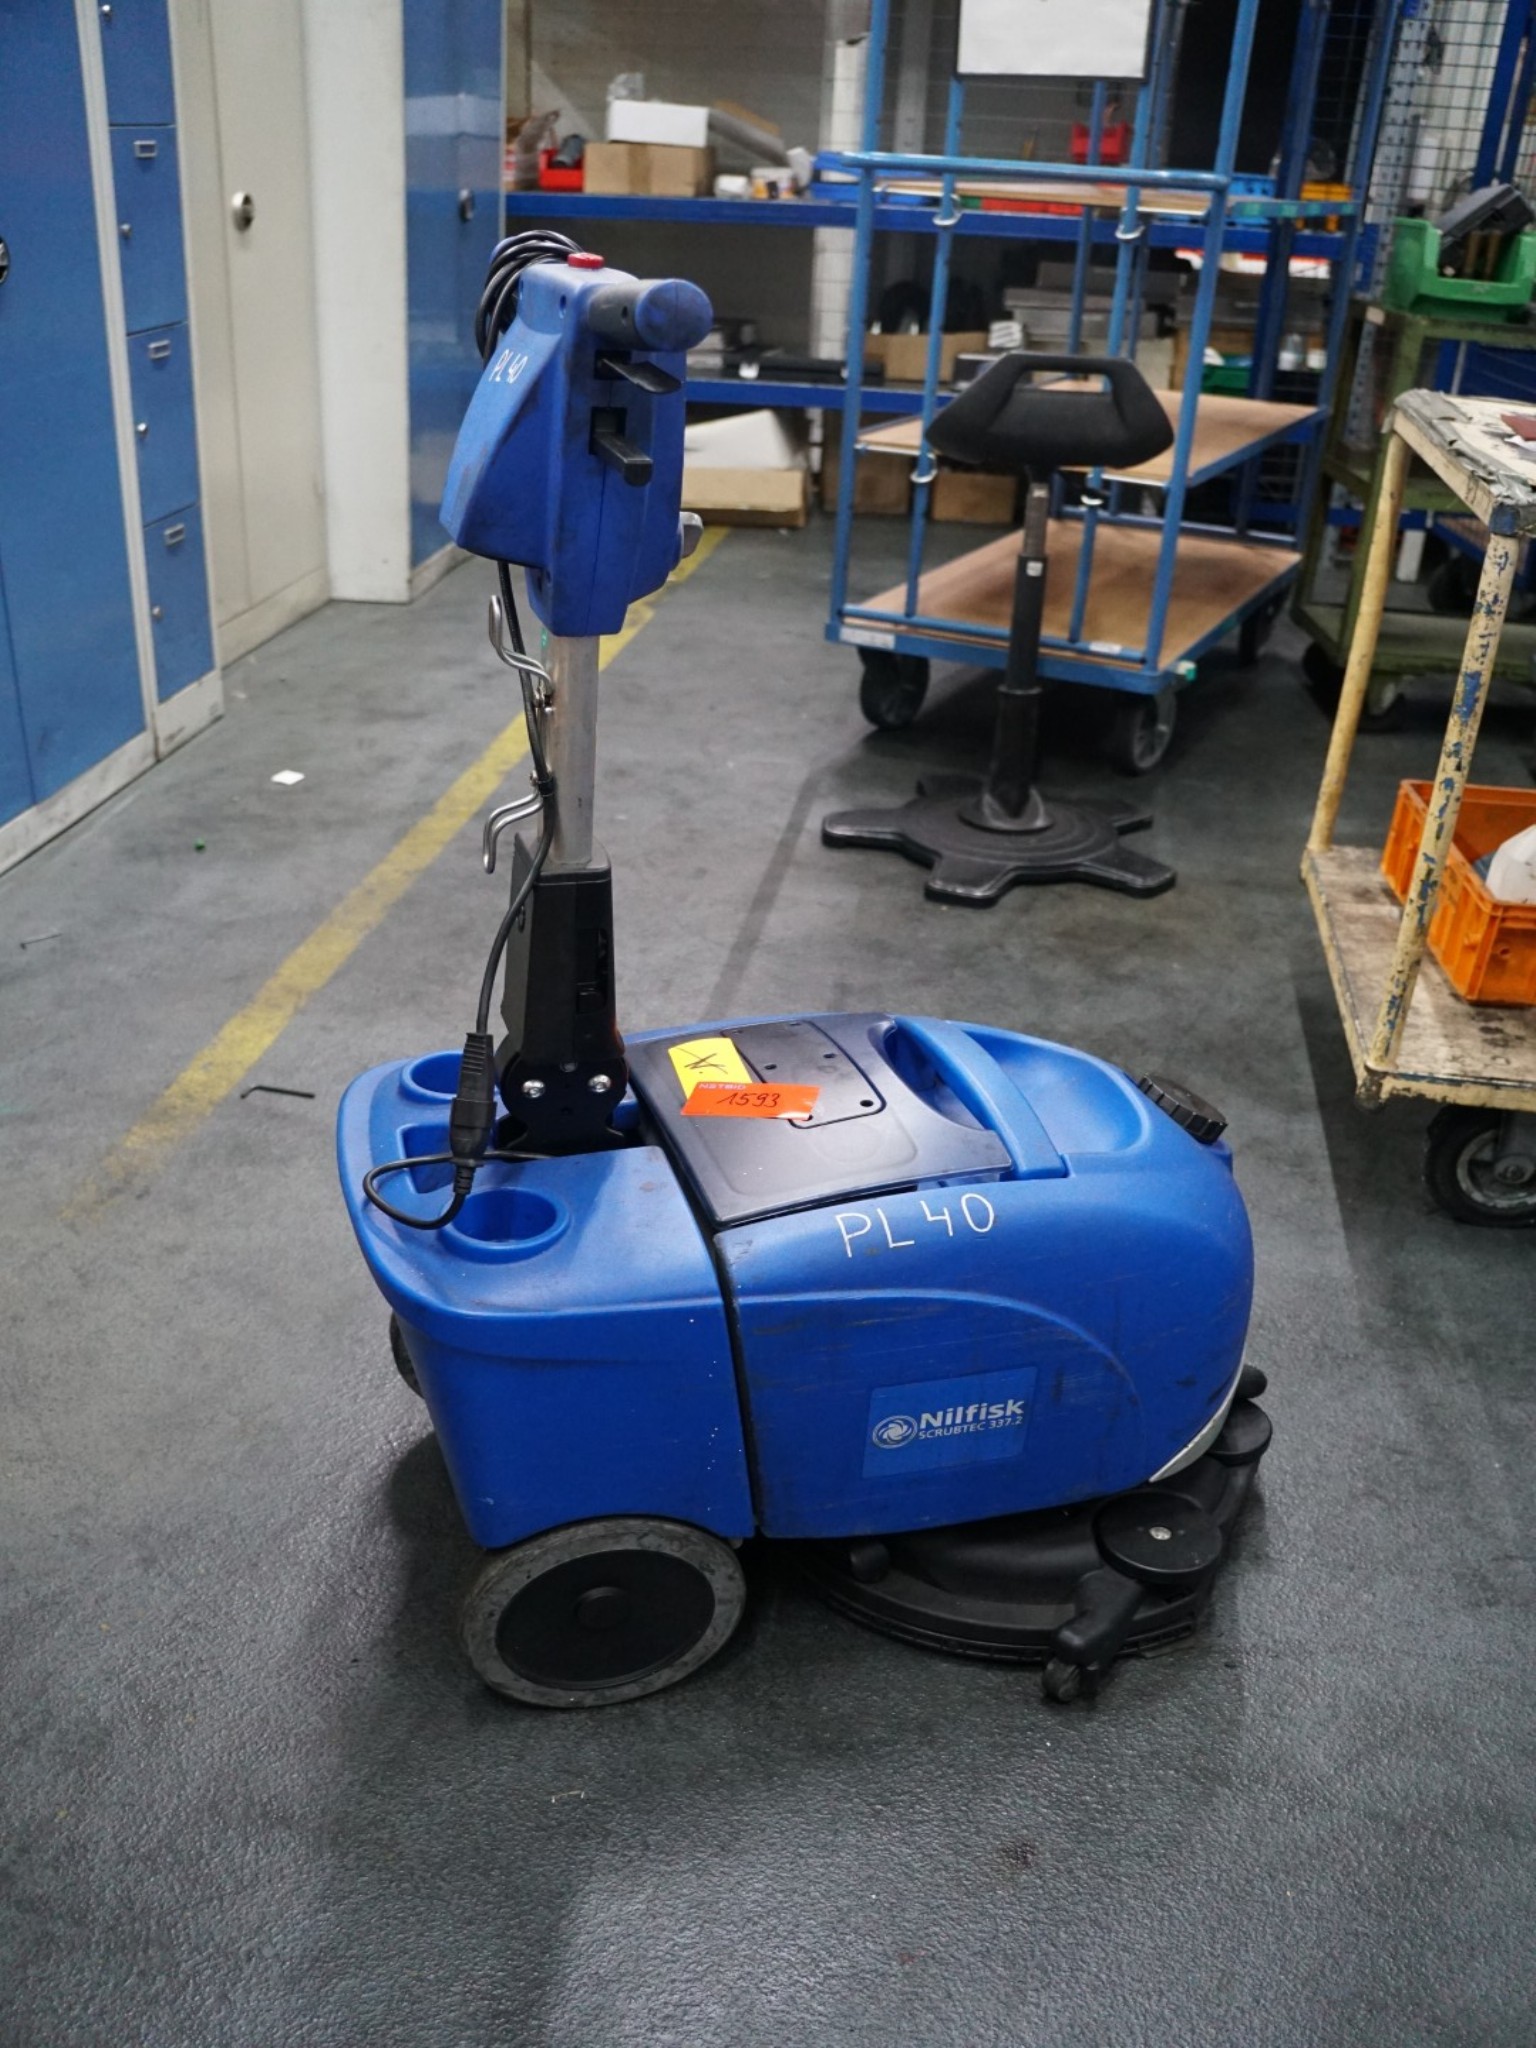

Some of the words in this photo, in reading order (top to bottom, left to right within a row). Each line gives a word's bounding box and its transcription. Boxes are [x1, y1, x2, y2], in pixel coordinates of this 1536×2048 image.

[488, 348, 514, 382] PL
[507, 352, 529, 384] 40
[716, 1092, 781, 1108] 1593
[835, 1207, 915, 1258] PL
[920, 1193, 995, 1237] 40
[918, 1421, 986, 1440] SCRUBTEC
[989, 1415, 1024, 1429] 337.2
[919, 1399, 1025, 1429] Nilfisk
